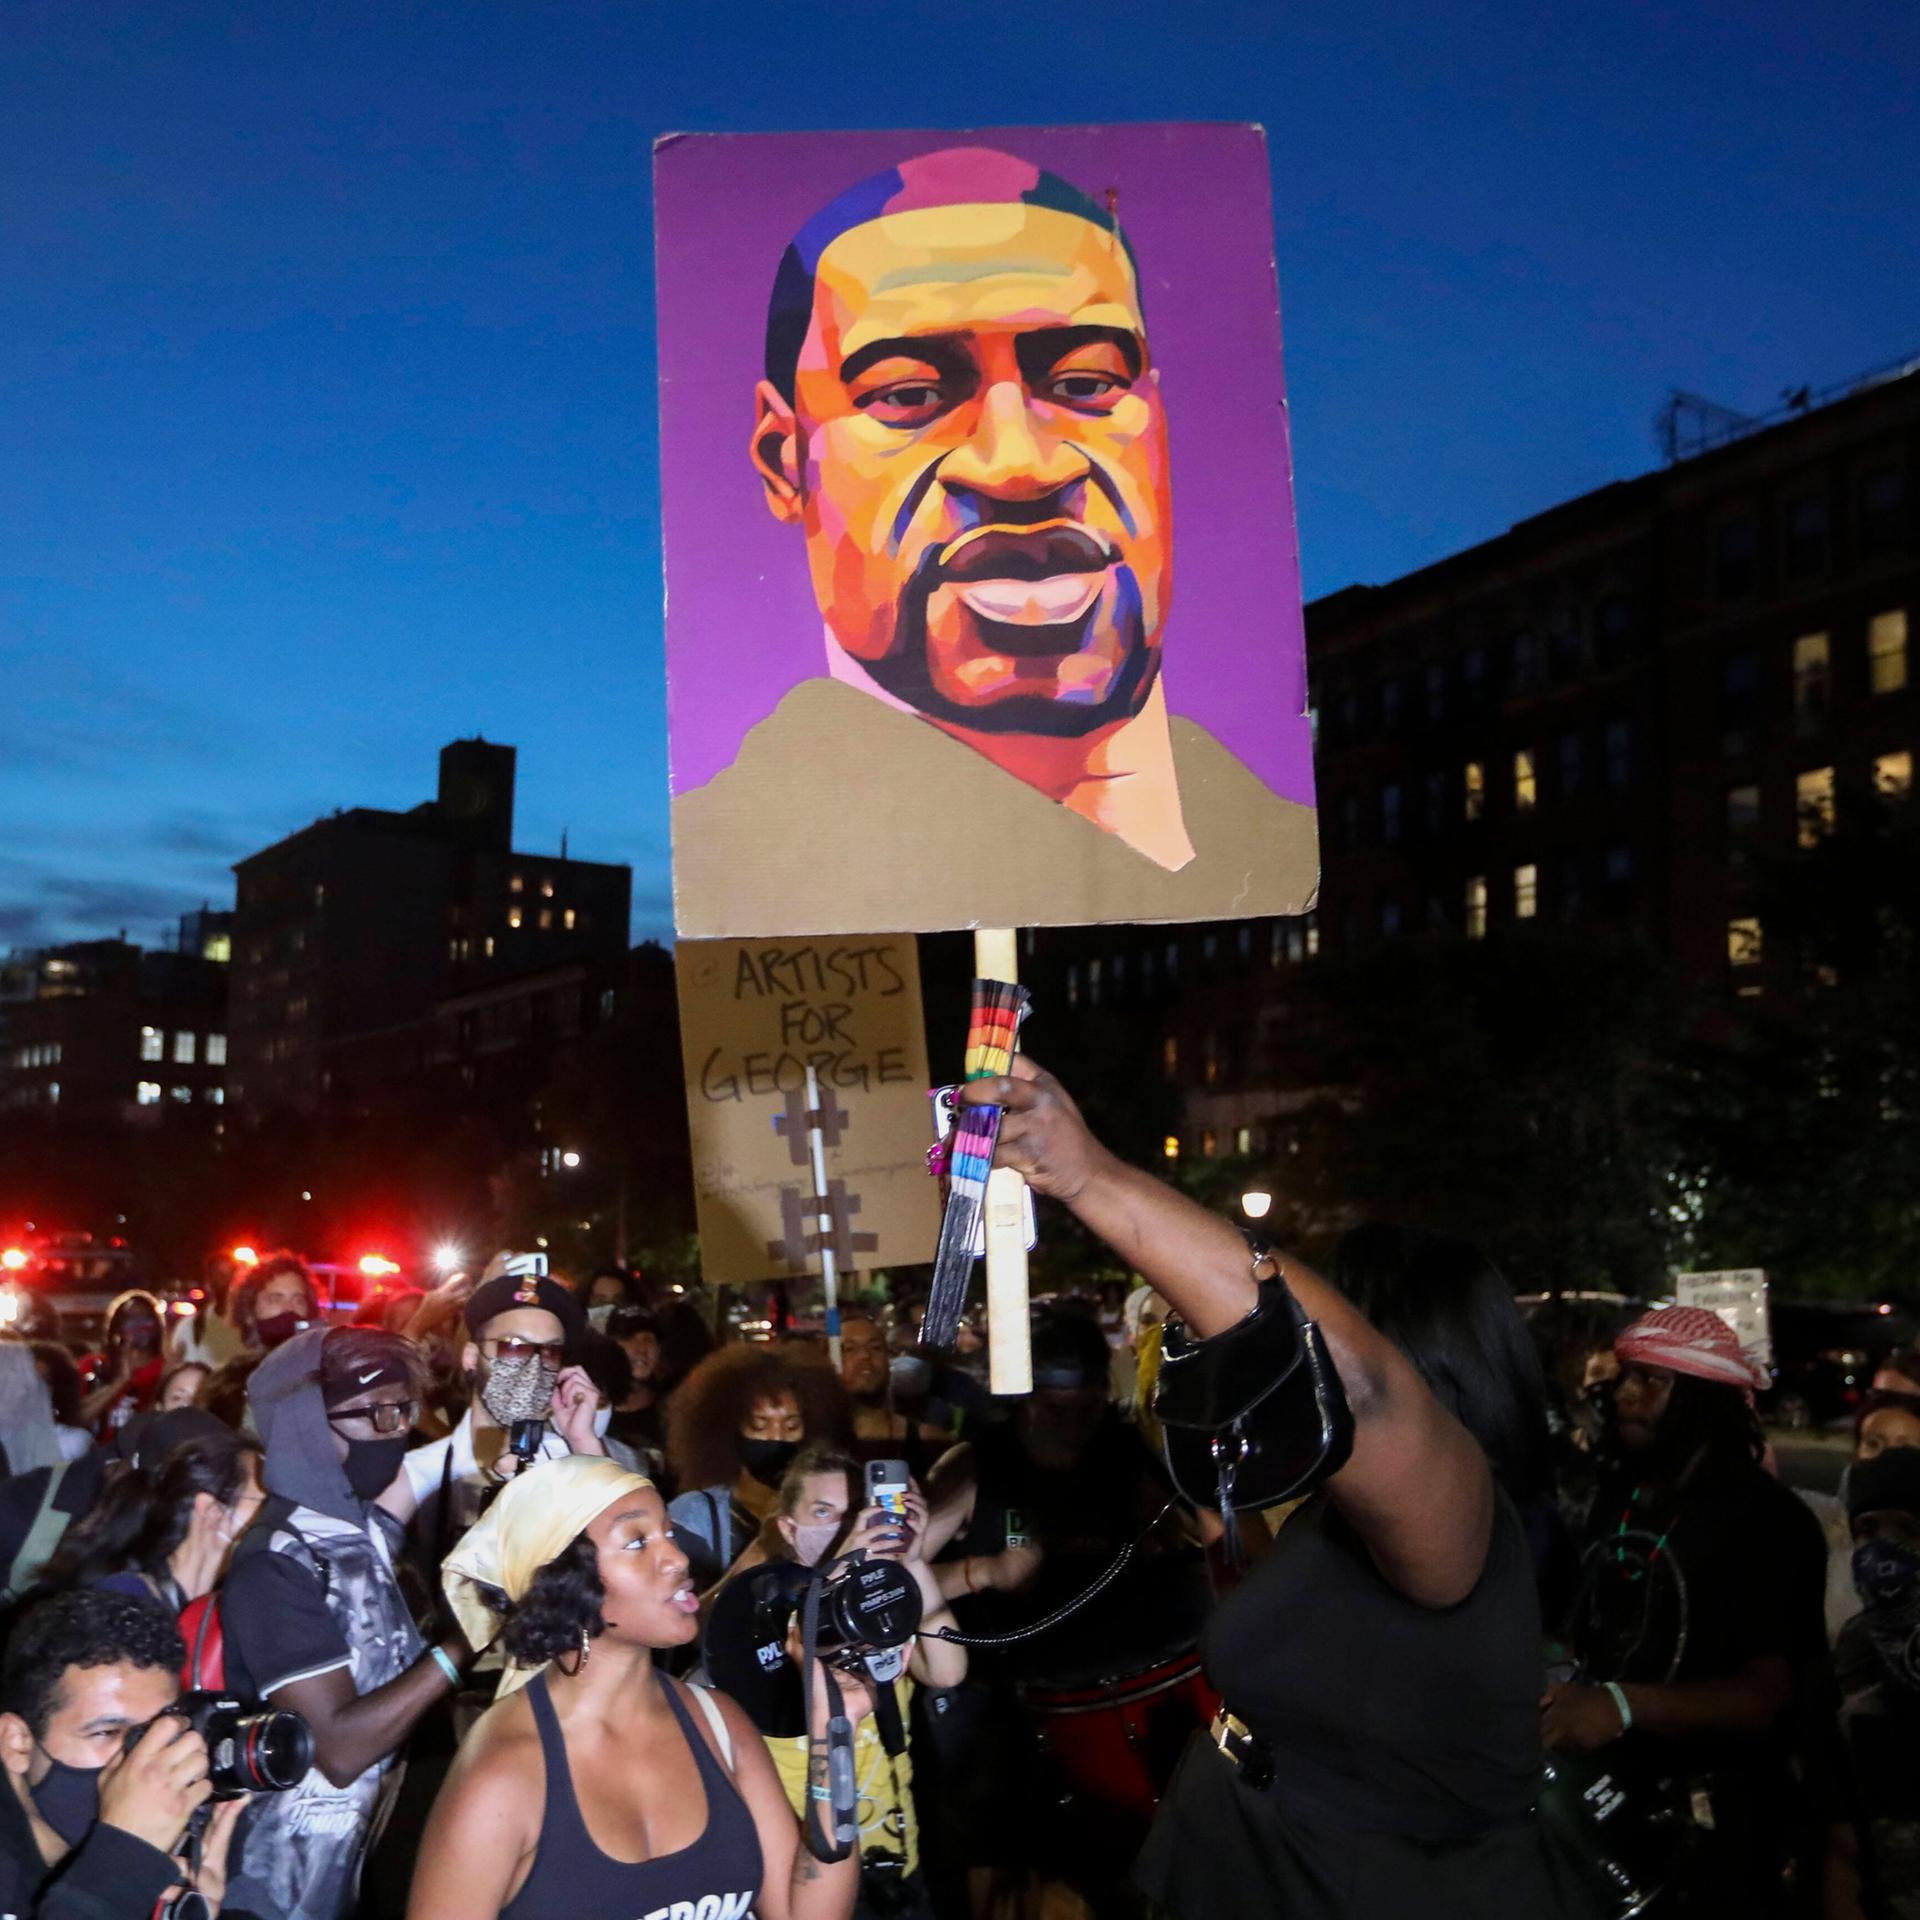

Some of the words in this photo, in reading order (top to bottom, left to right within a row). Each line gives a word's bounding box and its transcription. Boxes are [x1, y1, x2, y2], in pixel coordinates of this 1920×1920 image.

[734, 946, 905, 999] ARTISTS
[781, 1000, 857, 1047] FOR
[702, 1047, 913, 1102] GEORGE
[757, 1640, 783, 1665] PYL
